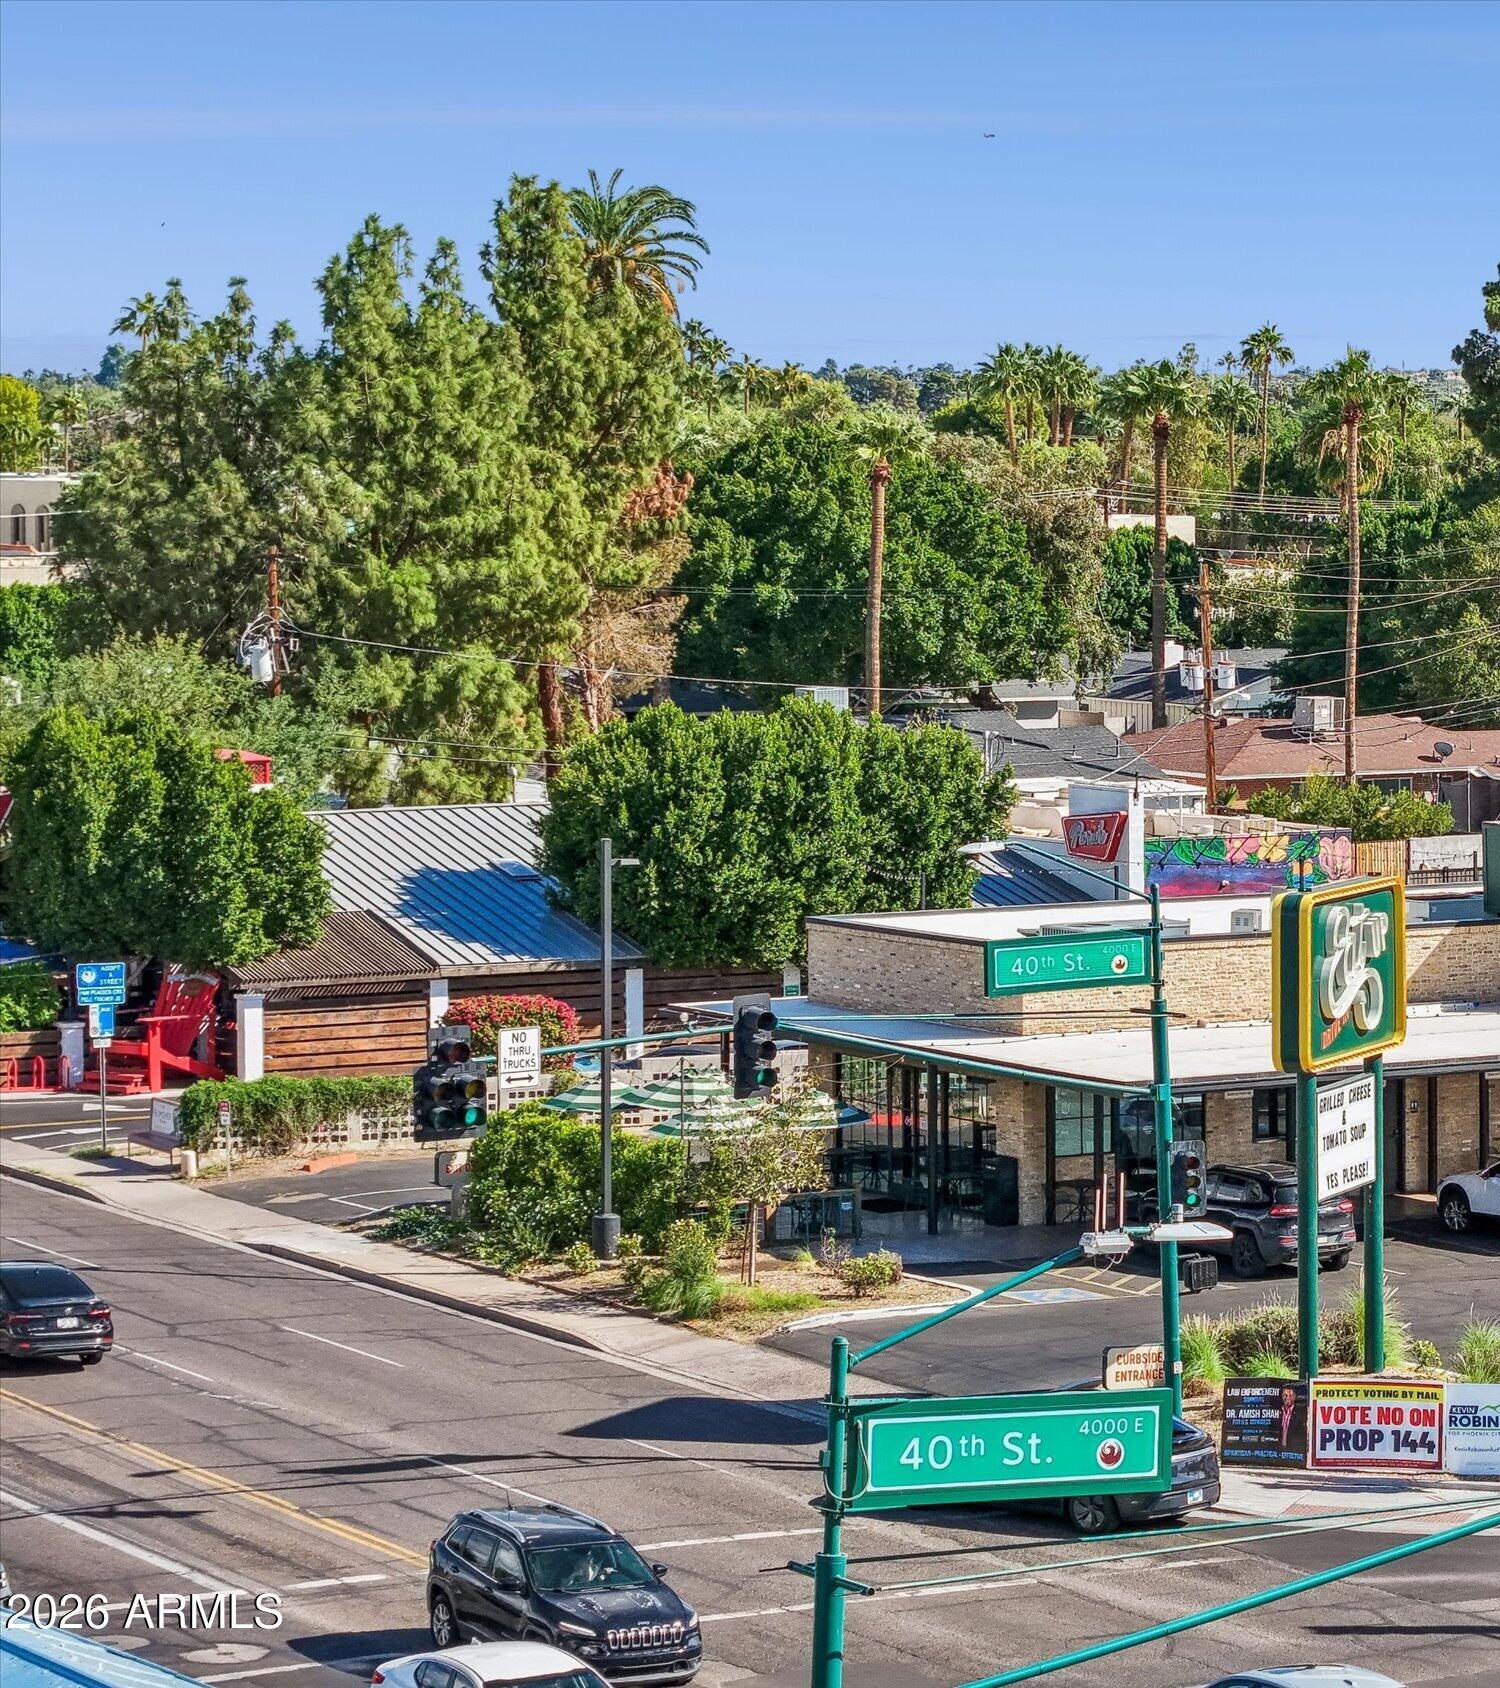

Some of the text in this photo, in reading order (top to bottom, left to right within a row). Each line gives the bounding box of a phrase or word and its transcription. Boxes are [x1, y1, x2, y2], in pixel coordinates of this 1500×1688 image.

[1102, 943, 1136, 954] 4000 E
[1011, 953, 1090, 976] 40th St.
[511, 1032, 527, 1043] NO
[508, 1045, 531, 1057] THRU
[503, 1059, 536, 1069] TRUCKS
[1319, 1083, 1371, 1113] GRILLED CHEESE
[1323, 1123, 1367, 1151] TOMATO SOUP
[1326, 1161, 1369, 1190] YES PLEASE!
[1116, 1351, 1163, 1366] CURBSIDE
[1115, 1367, 1164, 1383] ENTRANCE
[1227, 1387, 1280, 1397] LAW ENFORCEMENT
[1315, 1389, 1440, 1401] PROTECT VOTING BY MAIL
[1226, 1409, 1280, 1419] DR. AMISH SHAH
[1319, 1405, 1436, 1428] VOTE NO ON
[1078, 1417, 1144, 1435] 4000 E
[1319, 1428, 1436, 1455] PROP 144
[899, 1431, 1053, 1470] 40th St.
